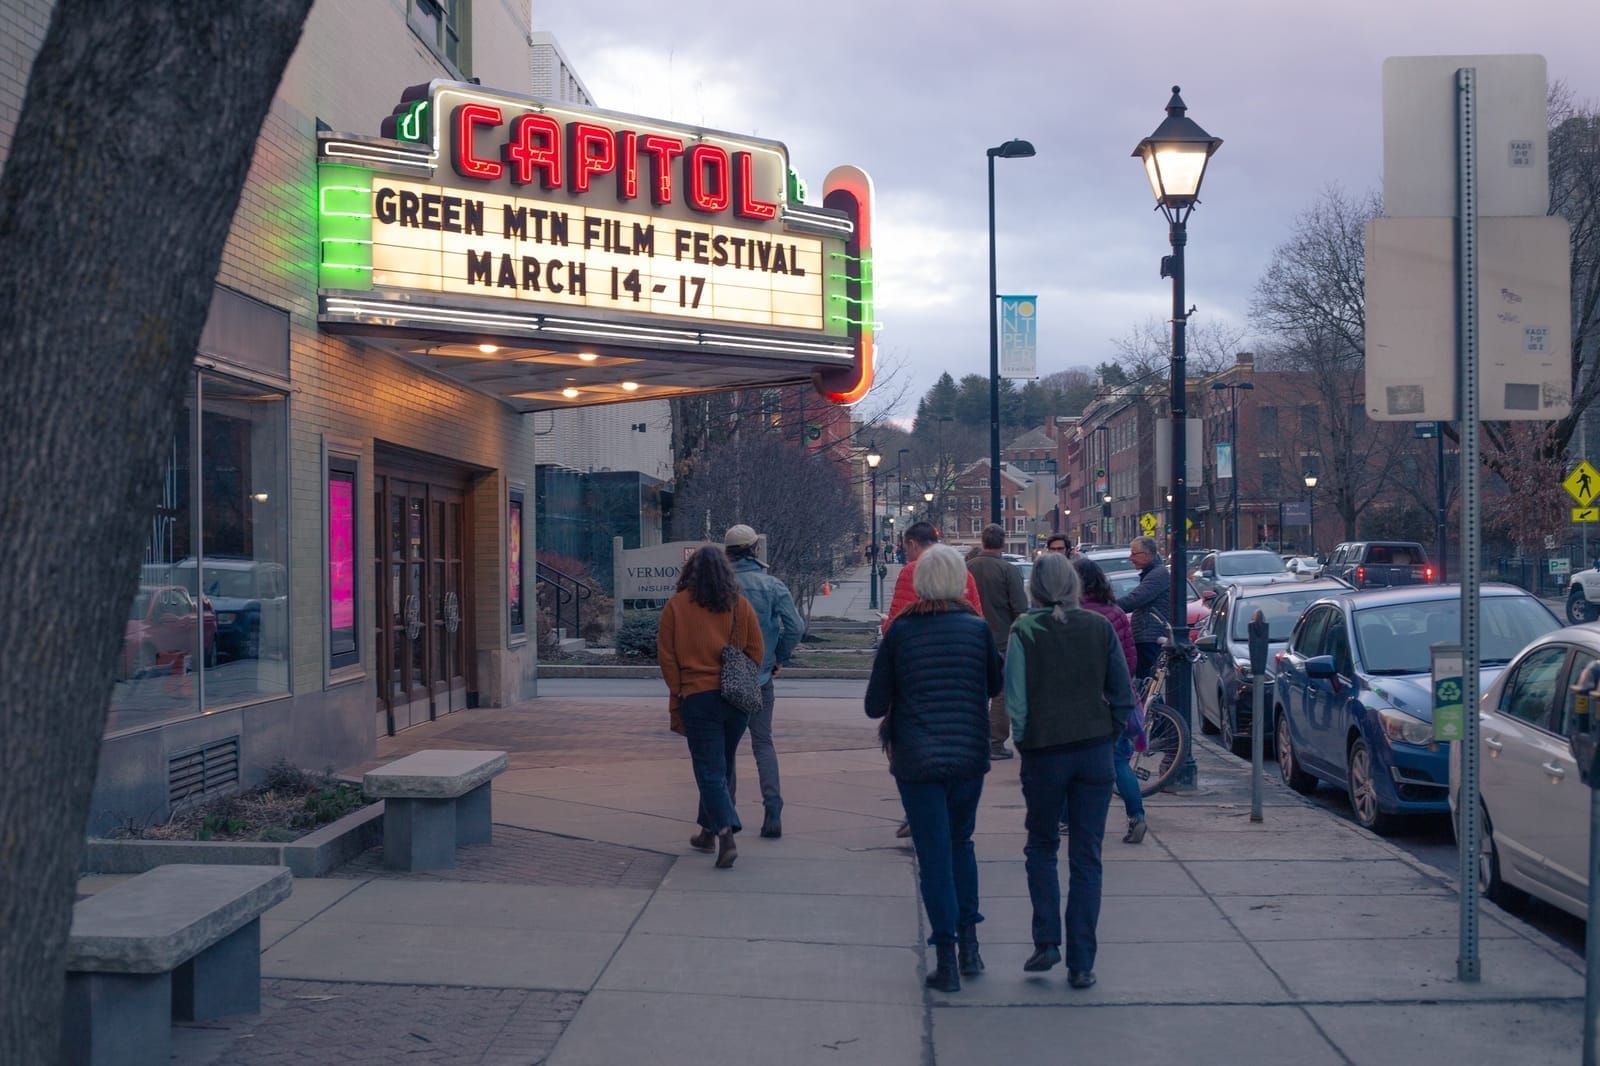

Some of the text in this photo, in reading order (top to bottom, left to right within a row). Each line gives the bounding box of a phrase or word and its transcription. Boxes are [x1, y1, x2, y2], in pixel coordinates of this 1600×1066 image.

[451, 103, 776, 220] CAPITOL
[375, 188, 805, 276] GREEN MTN FILM FESTIVAL
[467, 249, 587, 296] MARCH
